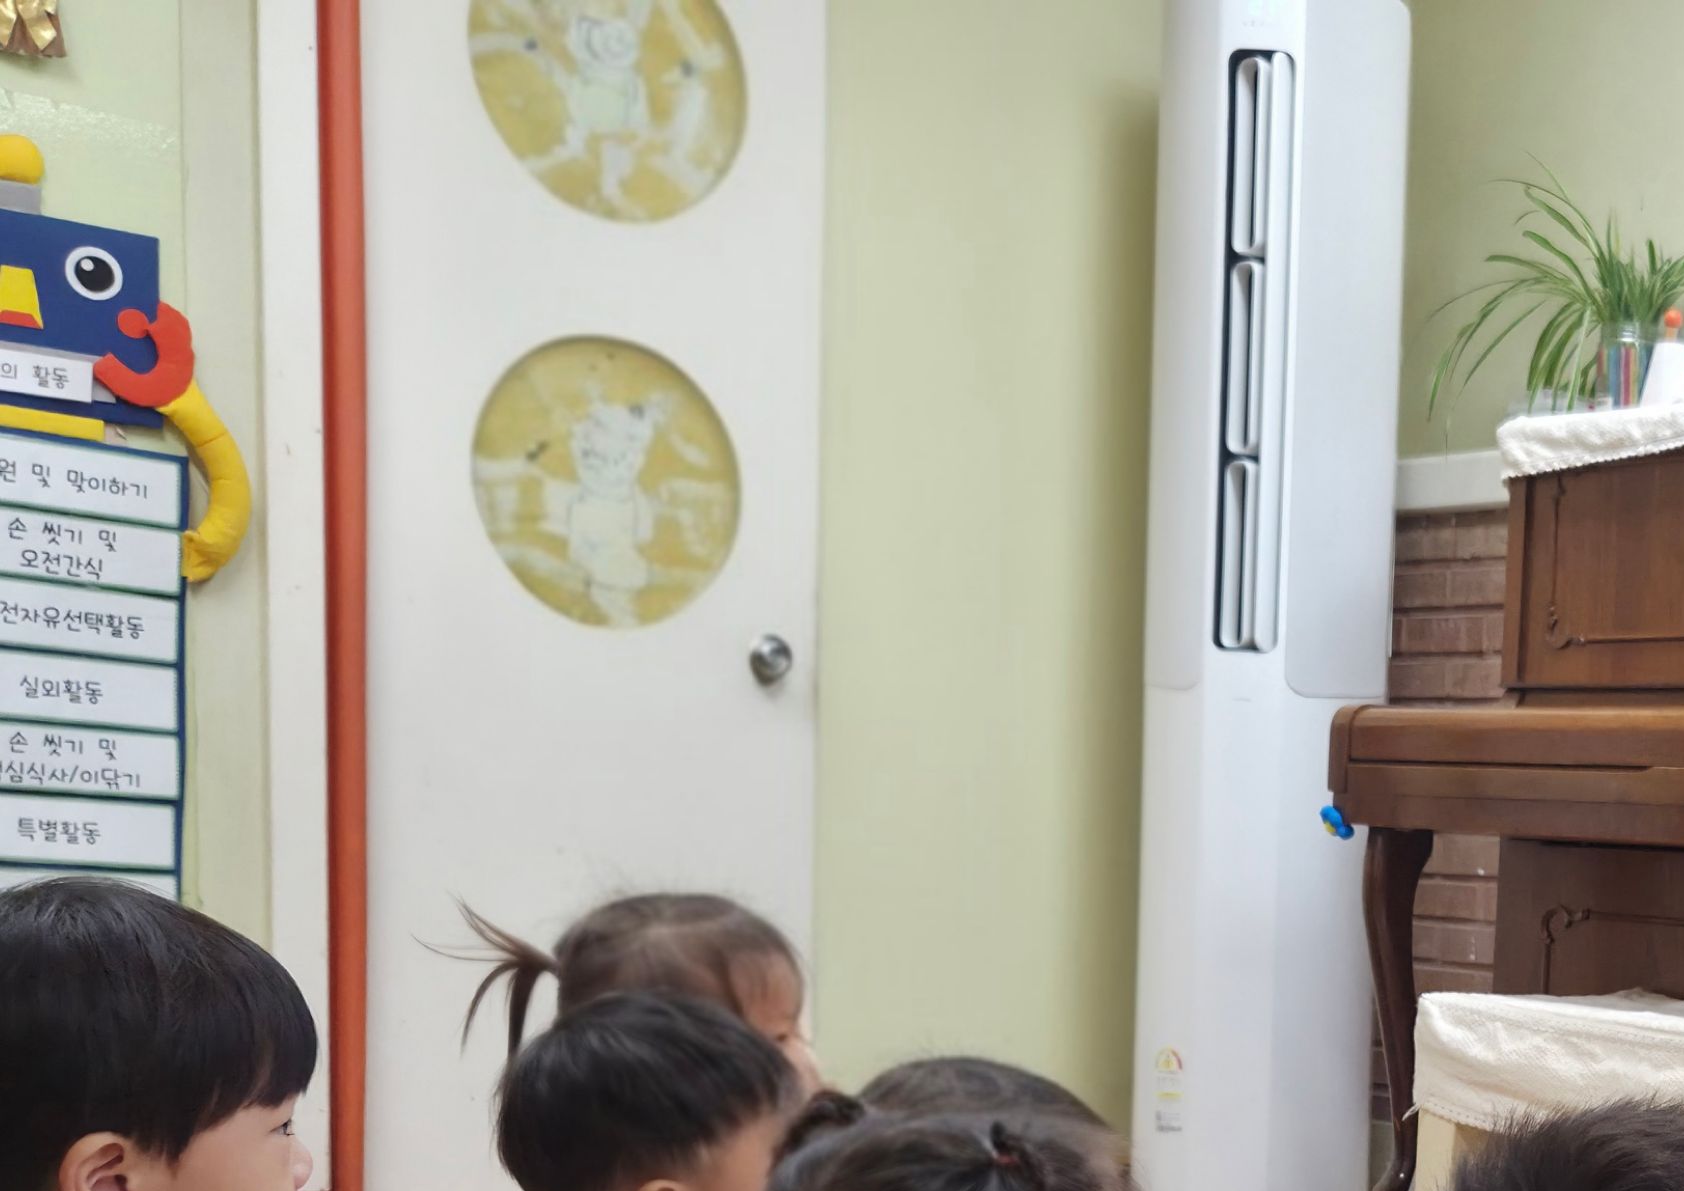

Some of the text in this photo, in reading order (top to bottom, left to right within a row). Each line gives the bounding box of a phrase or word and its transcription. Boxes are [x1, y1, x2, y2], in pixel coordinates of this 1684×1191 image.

[0, 362, 70, 389] 의 활동
[31, 463, 51, 488] 및
[66, 469, 148, 499] 맞이하기
[8, 517, 117, 552] 손 씻기 및
[20, 549, 103, 580] 오전간식
[20, 675, 104, 705] 실외활동
[9, 731, 118, 761] 손 씻기 및
[0, 760, 141, 790] 심식사/이닦기
[17, 817, 102, 845] 특별활동
